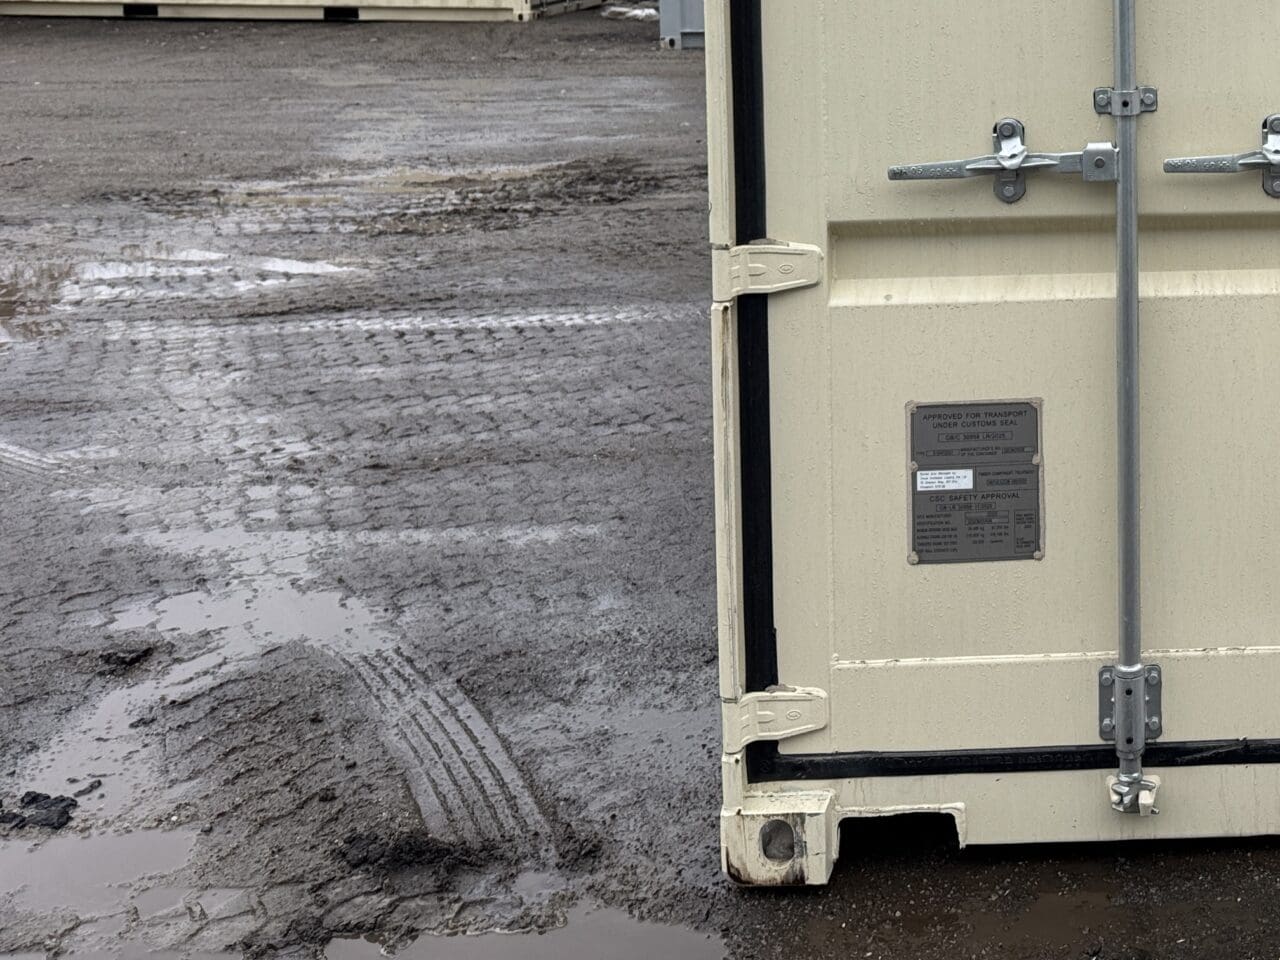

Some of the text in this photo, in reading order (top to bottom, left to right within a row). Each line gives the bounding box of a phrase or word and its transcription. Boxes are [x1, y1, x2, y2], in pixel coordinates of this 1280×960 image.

[923, 413, 962, 421] APPROVED
[984, 410, 1027, 418] TRANSPORT
[933, 419, 1018, 429] UNDER CUSTOMS SEAL
[930, 492, 1020, 503] CSC SAFETY APPROVAL
